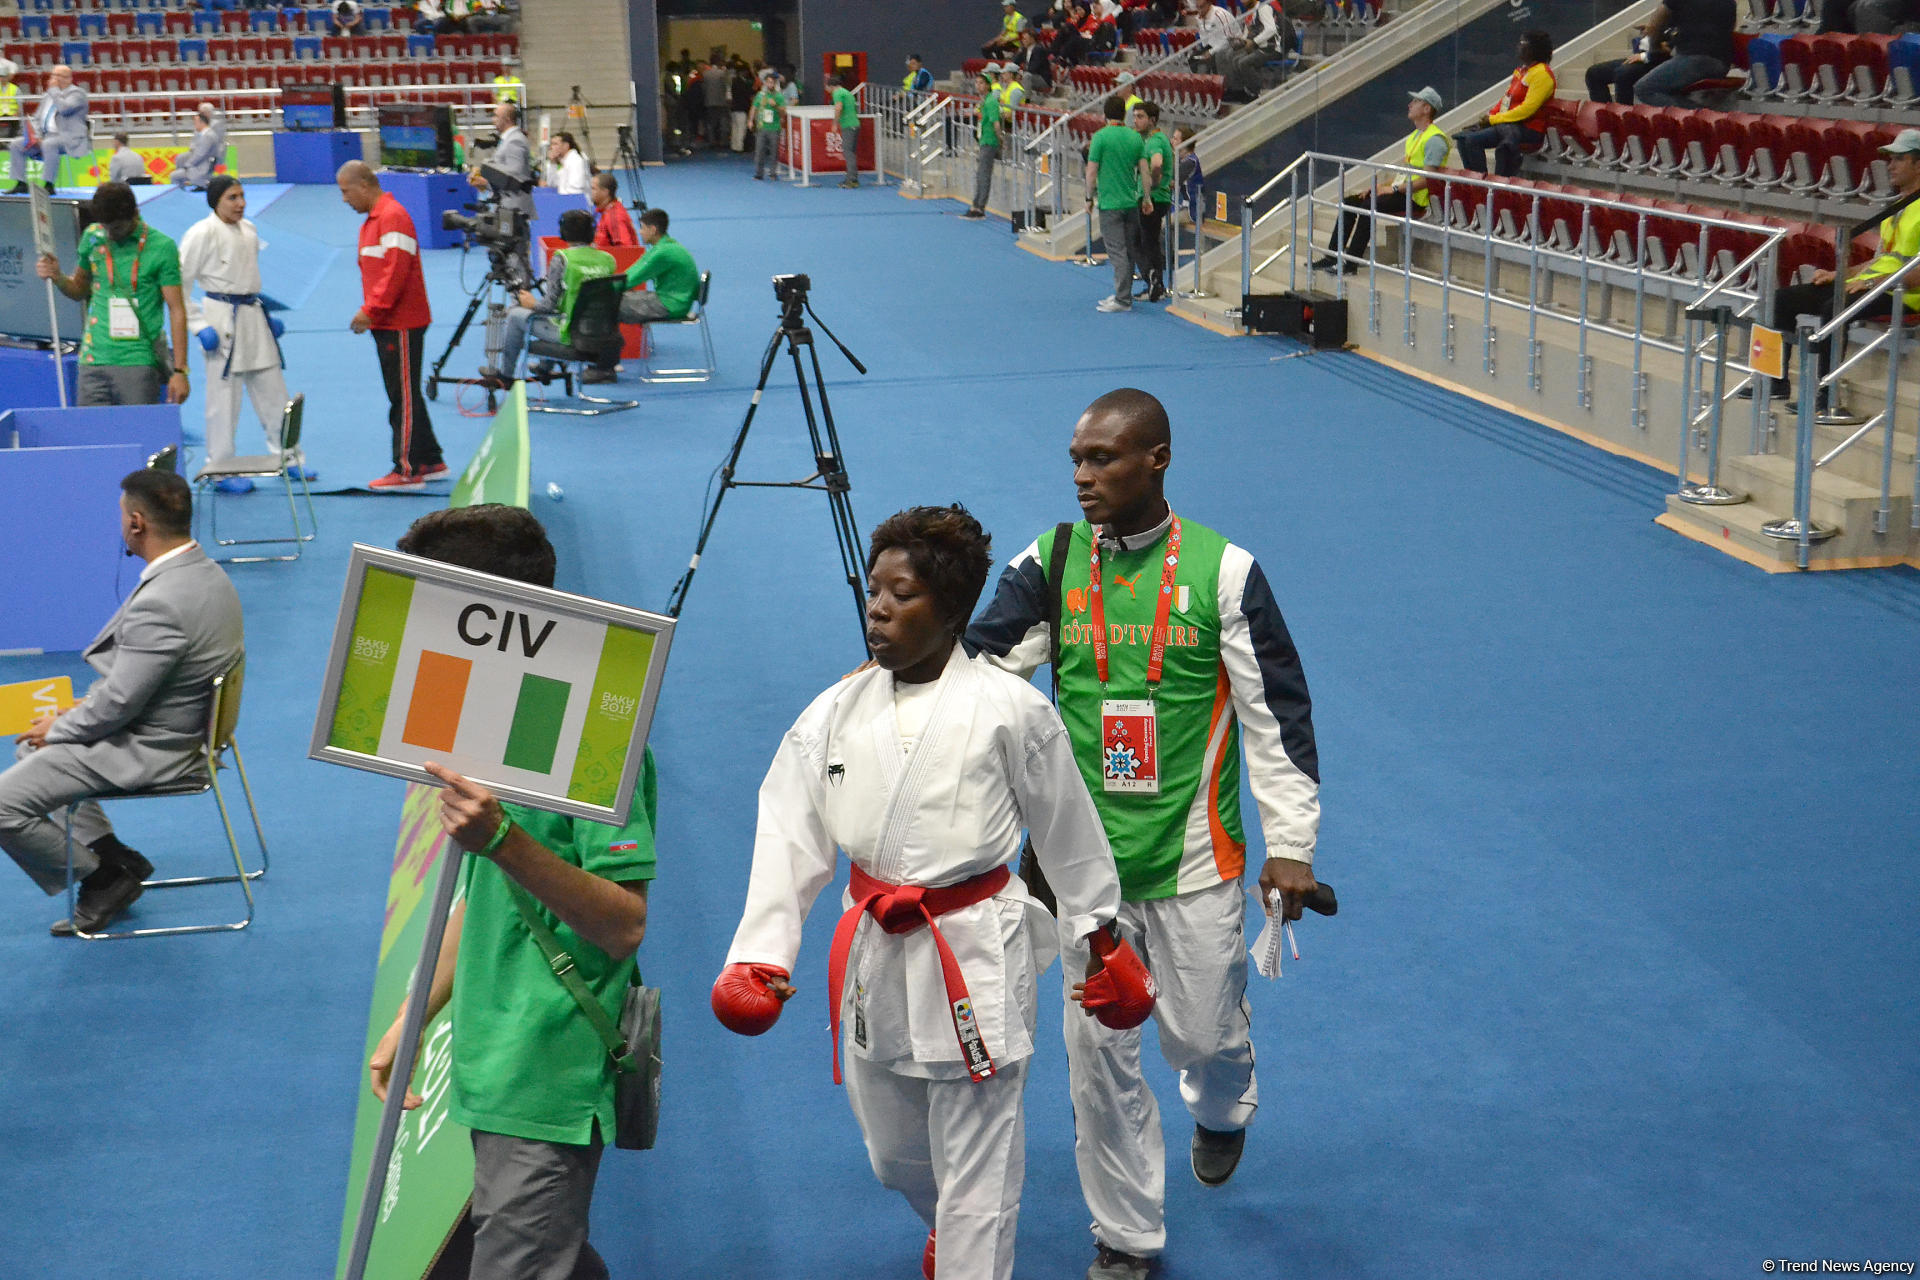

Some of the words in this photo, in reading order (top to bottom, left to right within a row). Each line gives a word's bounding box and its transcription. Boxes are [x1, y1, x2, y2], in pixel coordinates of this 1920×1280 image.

[457, 603, 558, 659] CIV
[1063, 619, 1093, 645] CÔT
[1110, 624, 1199, 646] D'IVIRE
[356, 636, 390, 651] BAKU
[354, 645, 388, 660] 2017
[602, 692, 636, 706] BAKU
[600, 701, 633, 715] 2017
